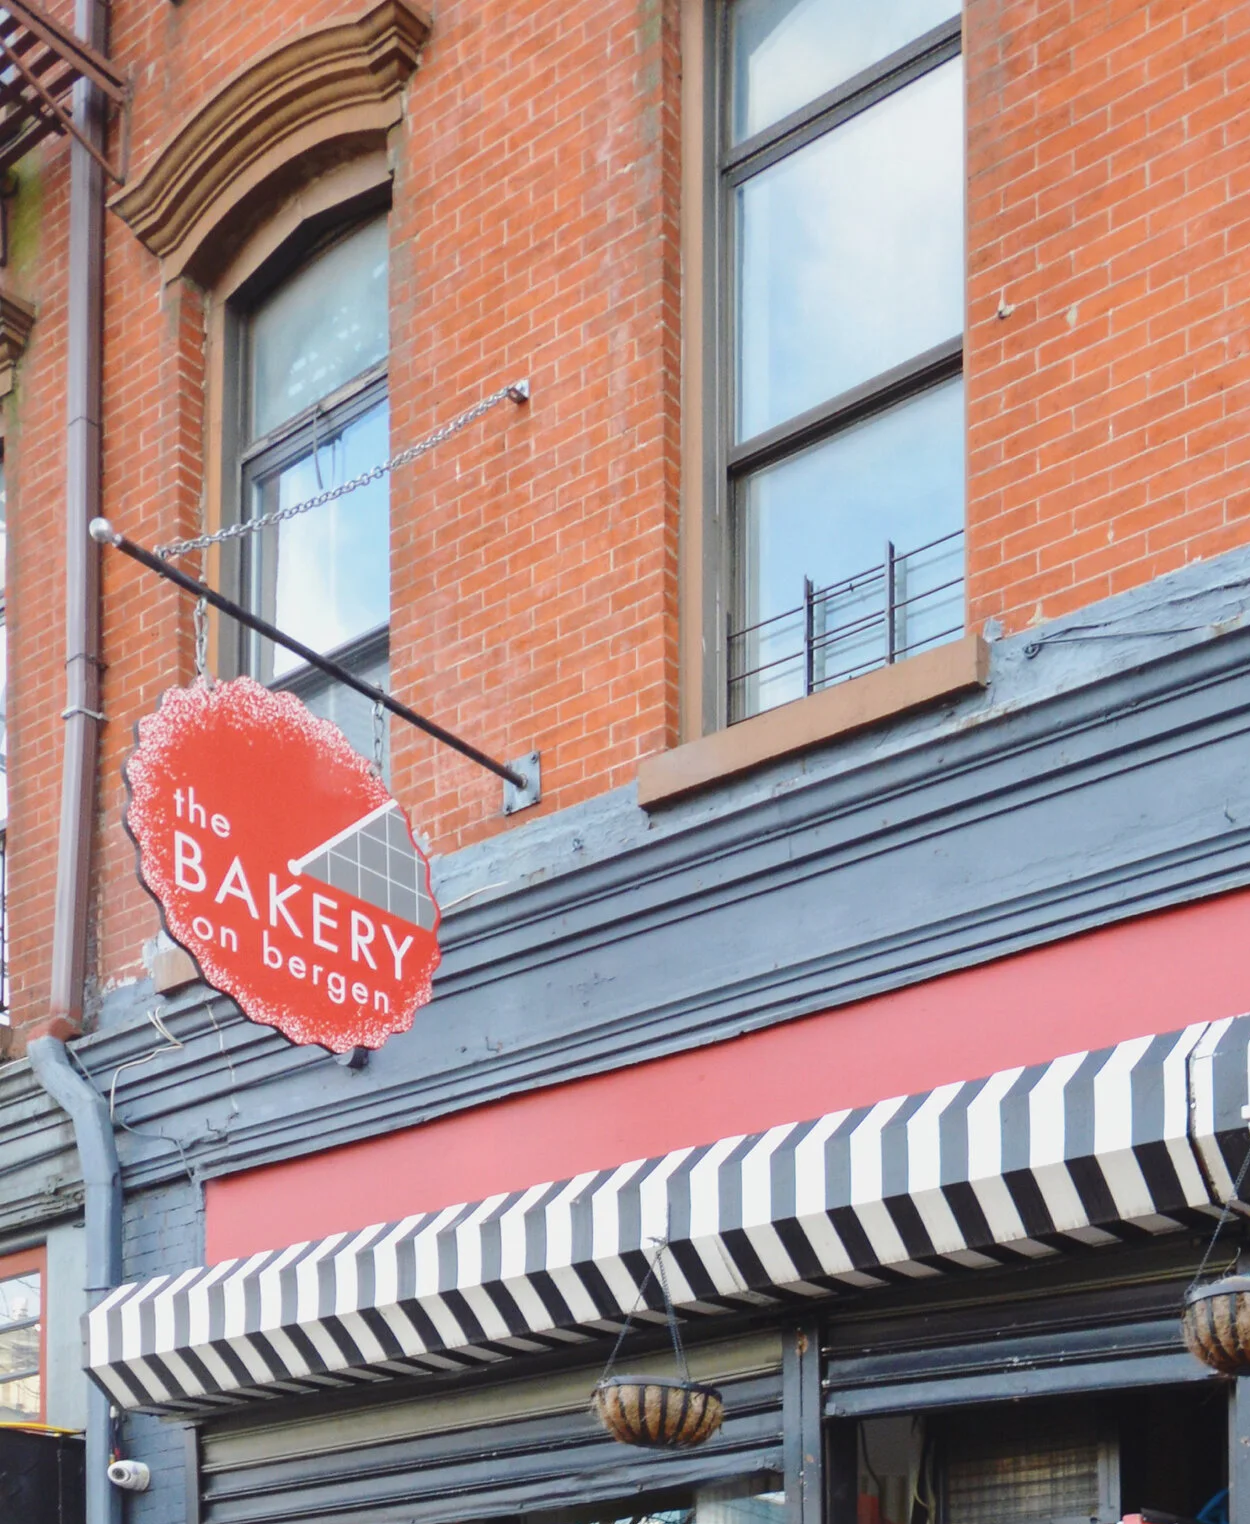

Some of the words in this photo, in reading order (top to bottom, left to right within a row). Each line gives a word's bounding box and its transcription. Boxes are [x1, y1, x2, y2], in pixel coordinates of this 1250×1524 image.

[173, 787, 230, 838] the
[174, 830, 414, 980] BAKERY
[193, 916, 238, 952] on
[263, 931, 389, 1013] bergen
